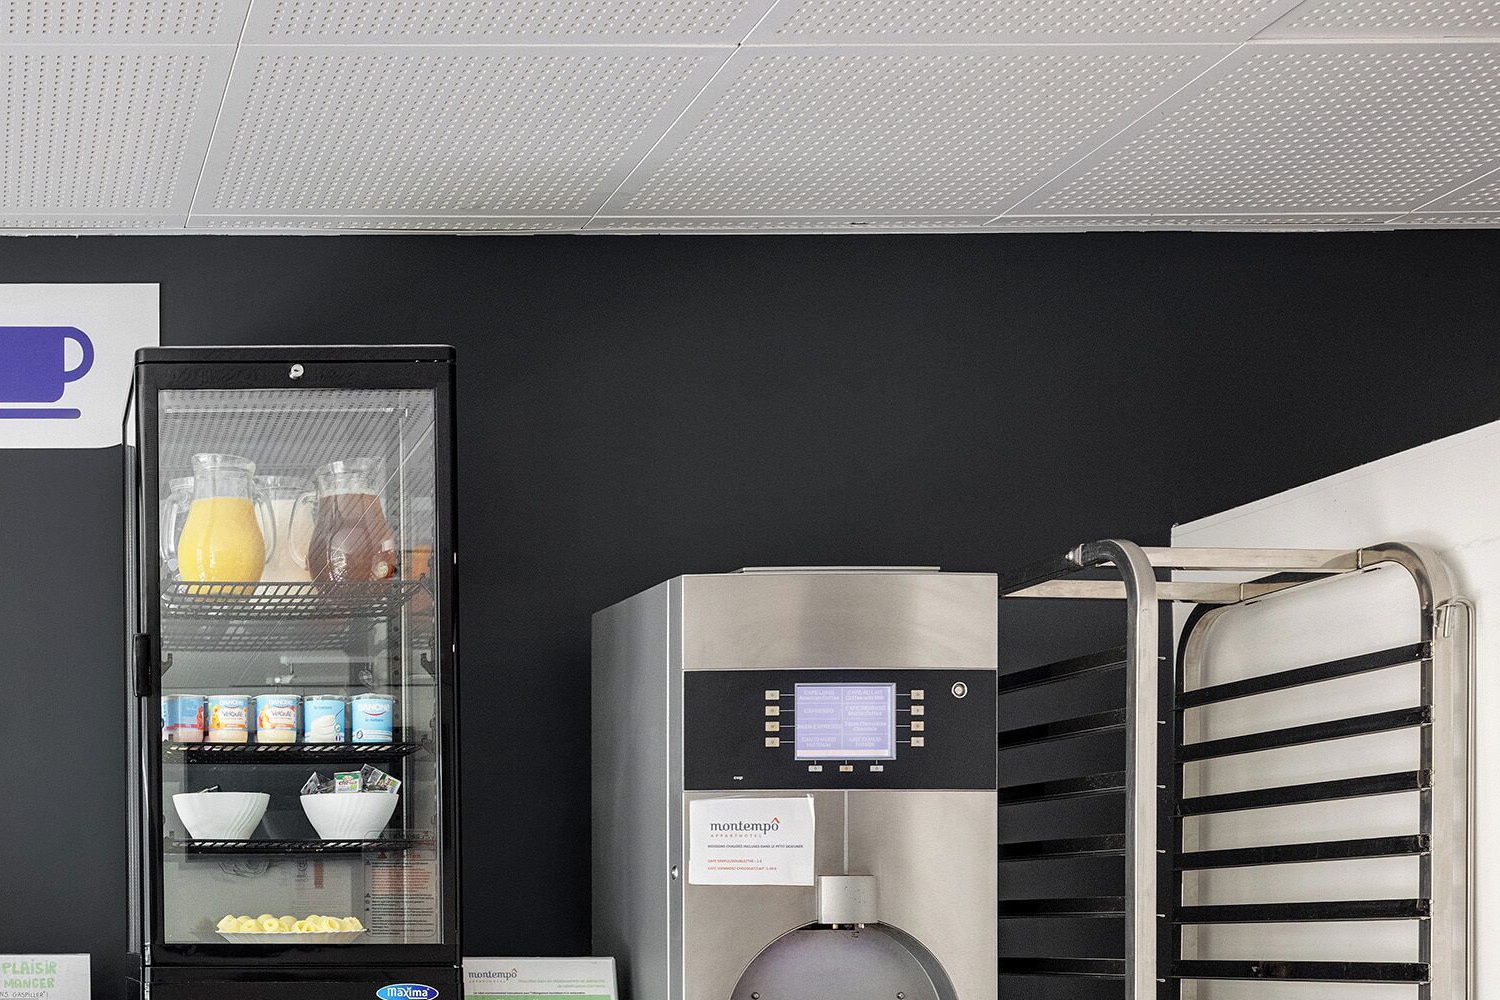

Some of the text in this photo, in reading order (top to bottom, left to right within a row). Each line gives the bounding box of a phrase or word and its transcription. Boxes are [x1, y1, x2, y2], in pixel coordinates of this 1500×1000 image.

[358, 703, 390, 711] DANONE
[710, 816, 780, 835] montempô
[468, 968, 517, 981] montempô
